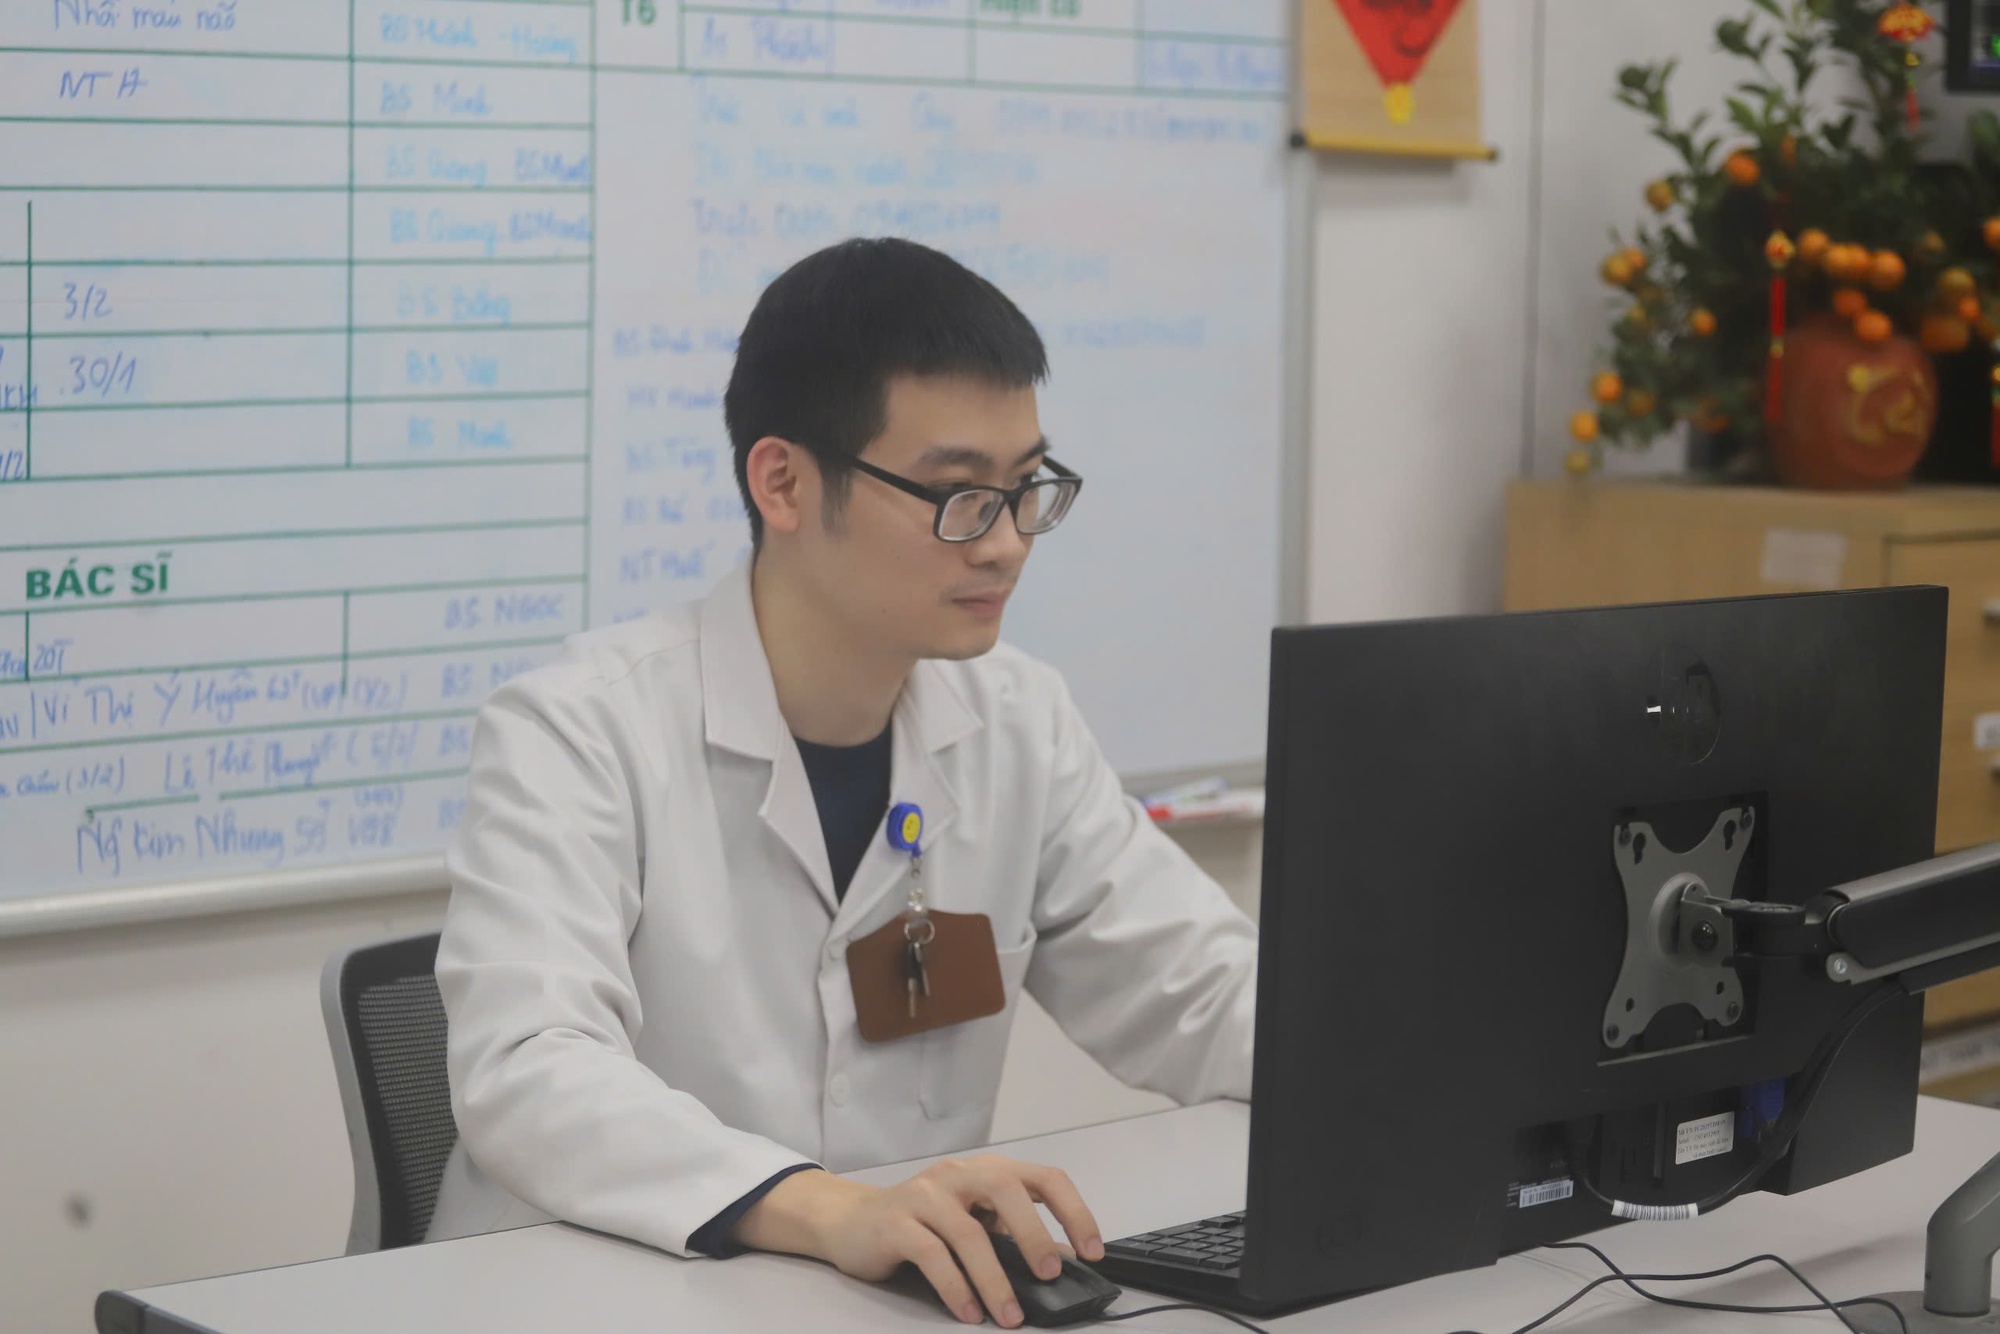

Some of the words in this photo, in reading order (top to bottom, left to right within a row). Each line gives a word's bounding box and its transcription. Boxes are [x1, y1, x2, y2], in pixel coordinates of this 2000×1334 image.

[63, 281, 114, 321] 3/2
[26, 557, 114, 600] BÁC
[130, 551, 173, 594] SĨ
